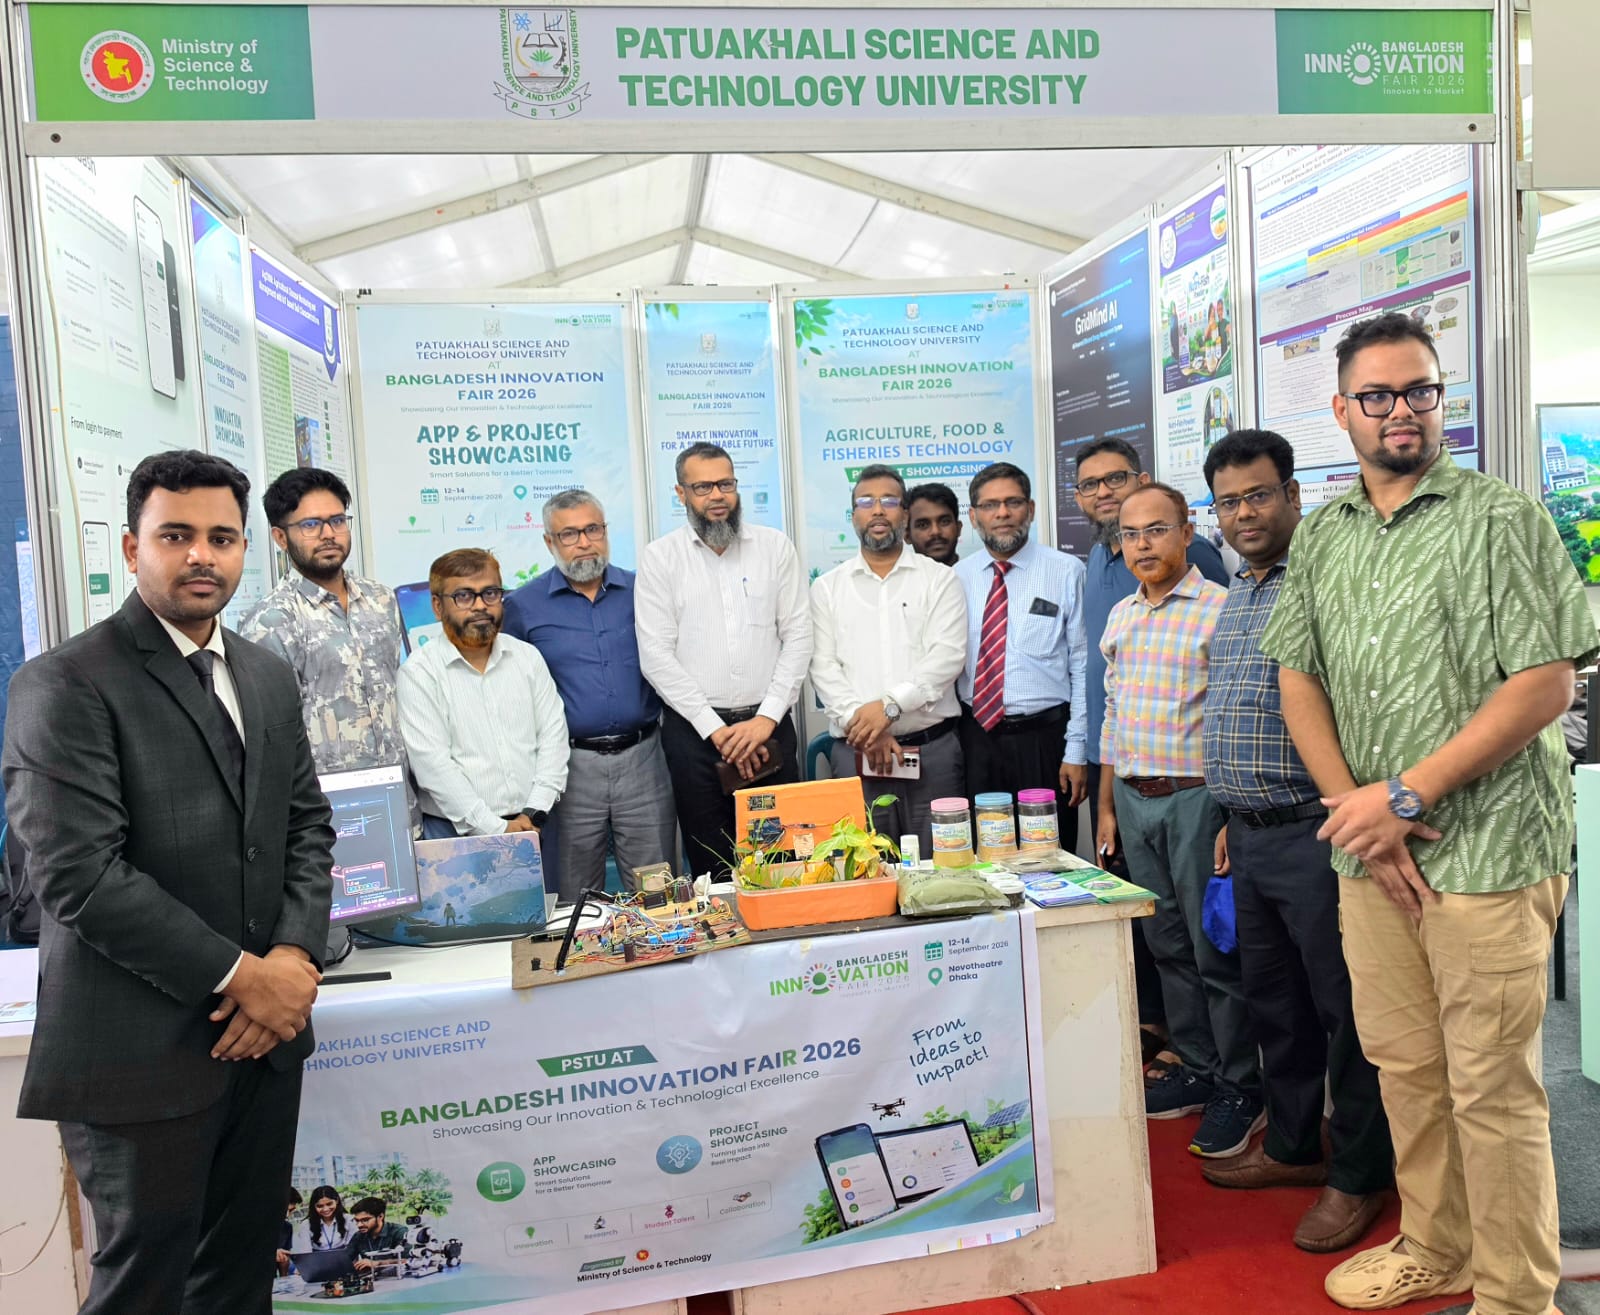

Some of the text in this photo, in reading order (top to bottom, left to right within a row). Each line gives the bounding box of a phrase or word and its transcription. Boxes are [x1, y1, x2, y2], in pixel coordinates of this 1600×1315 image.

[162, 38, 233, 57] Ministry
[240, 39, 258, 54] of
[615, 28, 1100, 60] PATUAKHALI SCIENCE AND
[1382, 42, 1464, 53] BANGLADESH
[500, 8, 580, 101] PATUAKHALI SCIENCE AND TECHNOLOGY UNIVERSITY
[163, 58, 253, 73] Science &
[164, 76, 268, 94] Technology
[1383, 75, 1465, 86] FAIR 2026
[618, 74, 1087, 107] TECHNOLOGY UNIVERSITY
[1383, 87, 1420, 95] Innovate
[1435, 87, 1465, 95] Market
[1075, 299, 1118, 335] GridMind AI
[1335, 310, 1358, 321] Process
[1358, 305, 1374, 315] Map
[842, 323, 984, 337] PATUAKHALI SCIENCE AND
[415, 339, 570, 350] PATUAKHALI SCIENCE AND
[843, 335, 981, 349] TECHNOLOGY UNIVERSITY
[416, 350, 567, 360] TECHNOLOGY UNIVERSITY
[908, 350, 921, 359] AT
[487, 361, 501, 370] AT
[713, 368, 752, 376] UNIVERSITY
[818, 360, 1014, 378] BANGLADESH INNOVATION
[386, 371, 604, 386] BANGLADESH INNOVATION
[882, 378, 953, 392] FAIR 2026
[458, 388, 537, 401] FAIR 2026
[658, 391, 765, 400] BANGLADESH INNOVATION
[417, 423, 581, 443] APP & PROJECT
[676, 429, 759, 440] SMART INNOVATION
[825, 422, 1005, 443] AGRICULTURE, FOOD &
[661, 439, 774, 451] FOR A FUTURE
[822, 440, 1014, 461] FISHERIES TECHNOLOGY
[428, 445, 572, 466] SHOWCASING
[430, 471, 453, 479] Smart
[455, 470, 490, 478] Solutions
[510, 469, 533, 477] Better
[535, 468, 573, 476] Tomorrow
[906, 464, 987, 477] SHOWCASING
[444, 493, 503, 502] September 2026
[948, 937, 970, 946] 12-14
[948, 940, 1009, 955] September 2026
[836, 950, 909, 968] BANGLADESH
[948, 959, 1003, 973] Novotheatre
[949, 972, 978, 983] Dhaka
[317, 1020, 491, 1053] AKHALI SCIENCE AND
[912, 1017, 966, 1046] From
[306, 1037, 487, 1072] HNOLOGY UNIVERSITY
[909, 1031, 982, 1068] Ideas to
[562, 1050, 634, 1072] PSTU AT
[916, 1046, 989, 1086] Impact!
[380, 1037, 861, 1129] BANGLADESH INNOVATION FAIR 2026
[432, 1068, 820, 1140] Showcasing Our Innovation & Technological Excellence
[709, 1121, 759, 1137] PROJECT
[710, 1126, 788, 1149] SHOWCASING
[533, 1155, 556, 1166] APP
[711, 1149, 737, 1158] Turning
[534, 1157, 616, 1177] SHOWCASING
[535, 1174, 591, 1187] Smart Solutions
[576, 1179, 612, 1189] Tomorrow
[513, 1200, 766, 1250] Innovation Research Student Talent Collaboration
[577, 1271, 611, 1283] Ministry
[622, 1264, 655, 1275] Science
[664, 1253, 712, 1267] Technology
